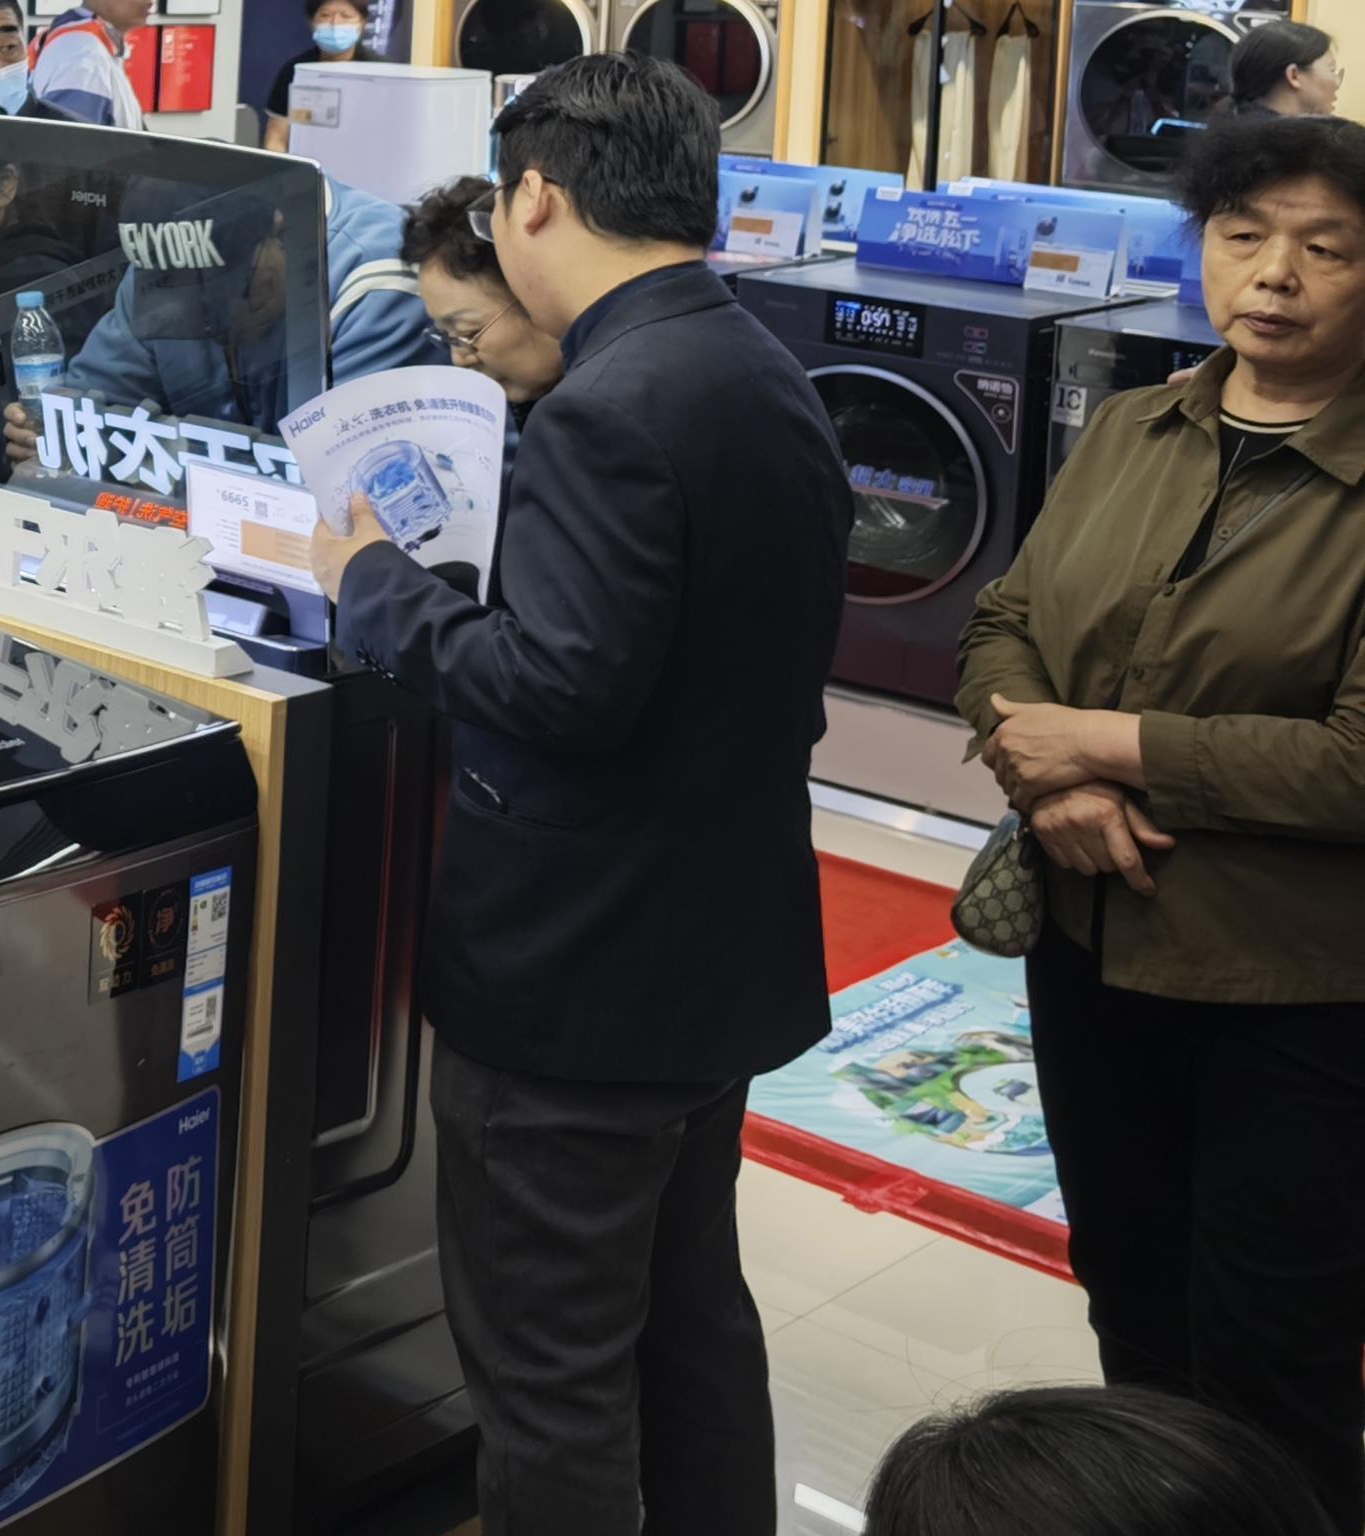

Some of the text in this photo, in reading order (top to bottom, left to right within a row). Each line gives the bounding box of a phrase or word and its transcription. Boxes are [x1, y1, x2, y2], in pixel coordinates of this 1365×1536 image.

[288, 406, 326, 438] Haier
[177, 1106, 211, 1136] Haier
[114, 1178, 157, 1368] 免清洗
[160, 1154, 203, 1338] 防筒垢
